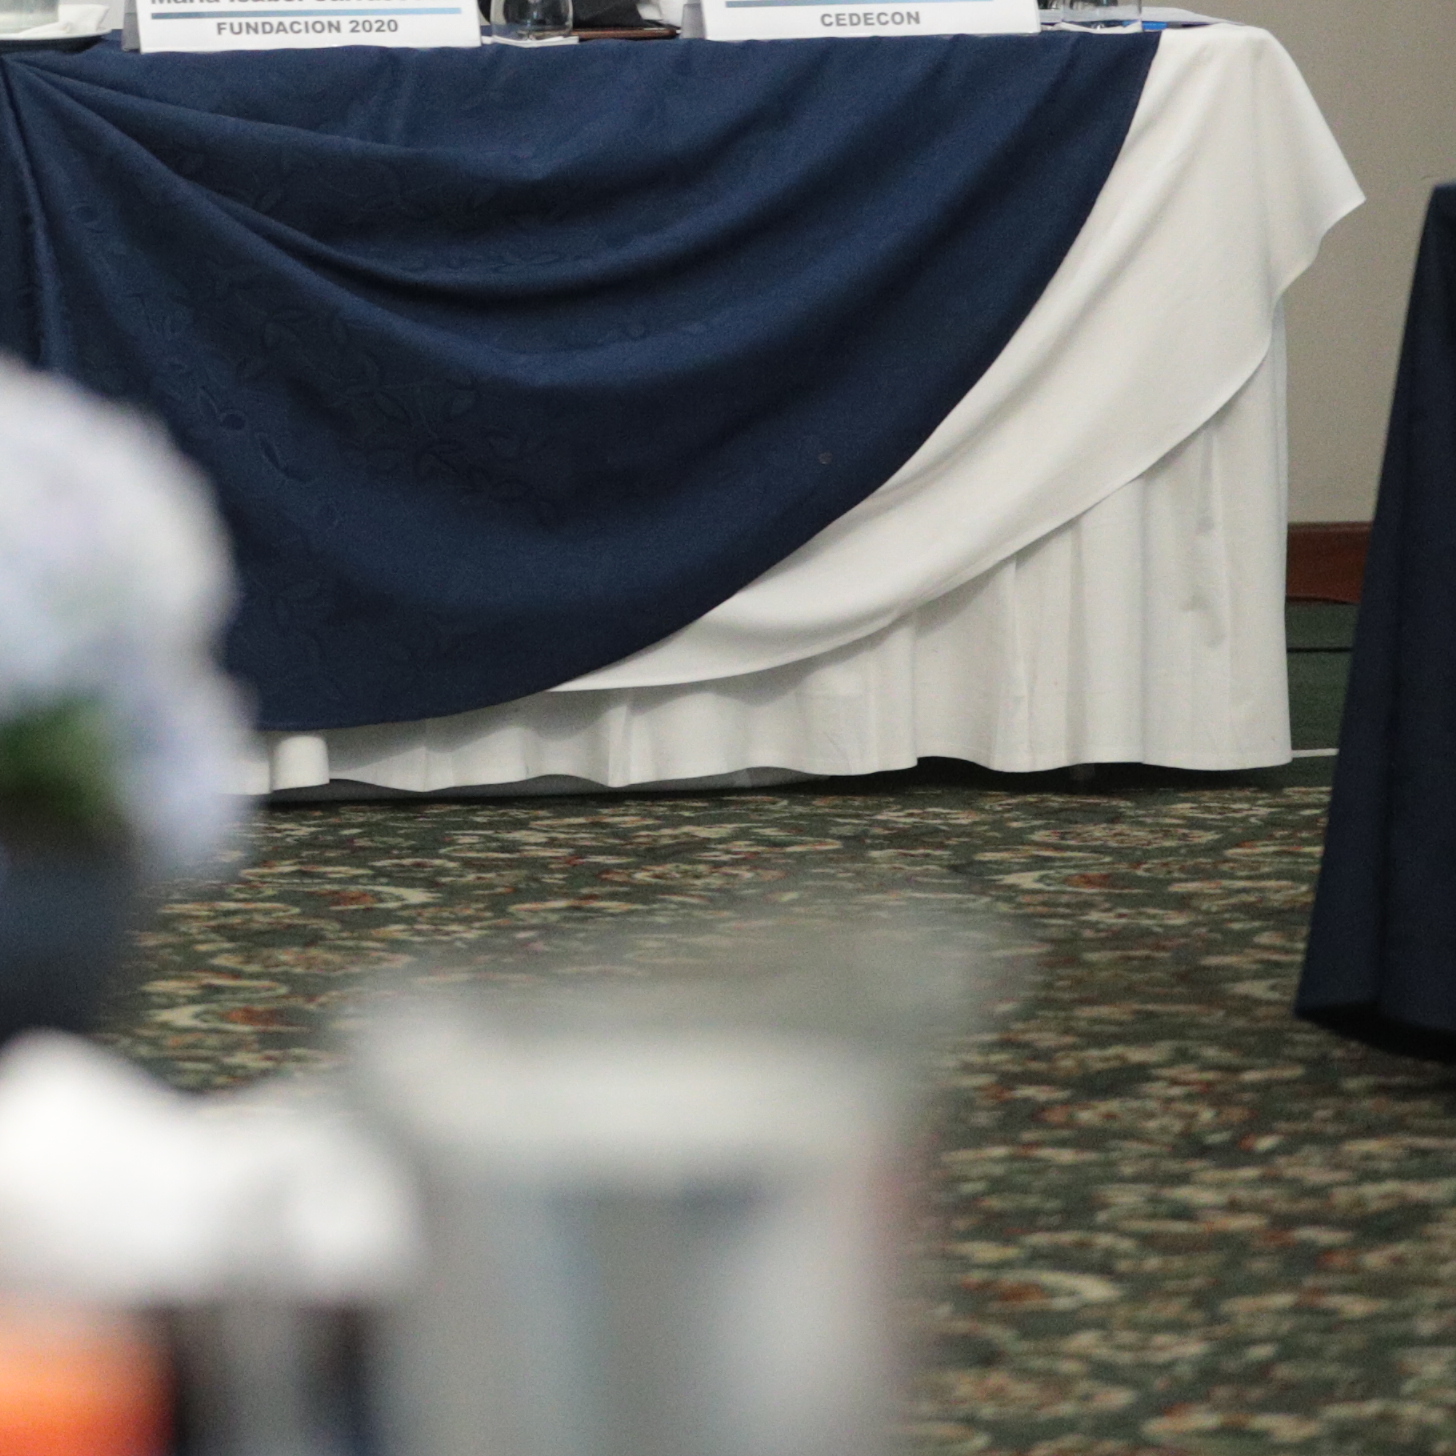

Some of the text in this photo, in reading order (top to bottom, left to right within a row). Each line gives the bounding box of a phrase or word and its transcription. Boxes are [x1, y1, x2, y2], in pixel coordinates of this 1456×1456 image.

[216, 18, 399, 36] FUNDACION 2020
[820, 11, 921, 28] CEDECON
